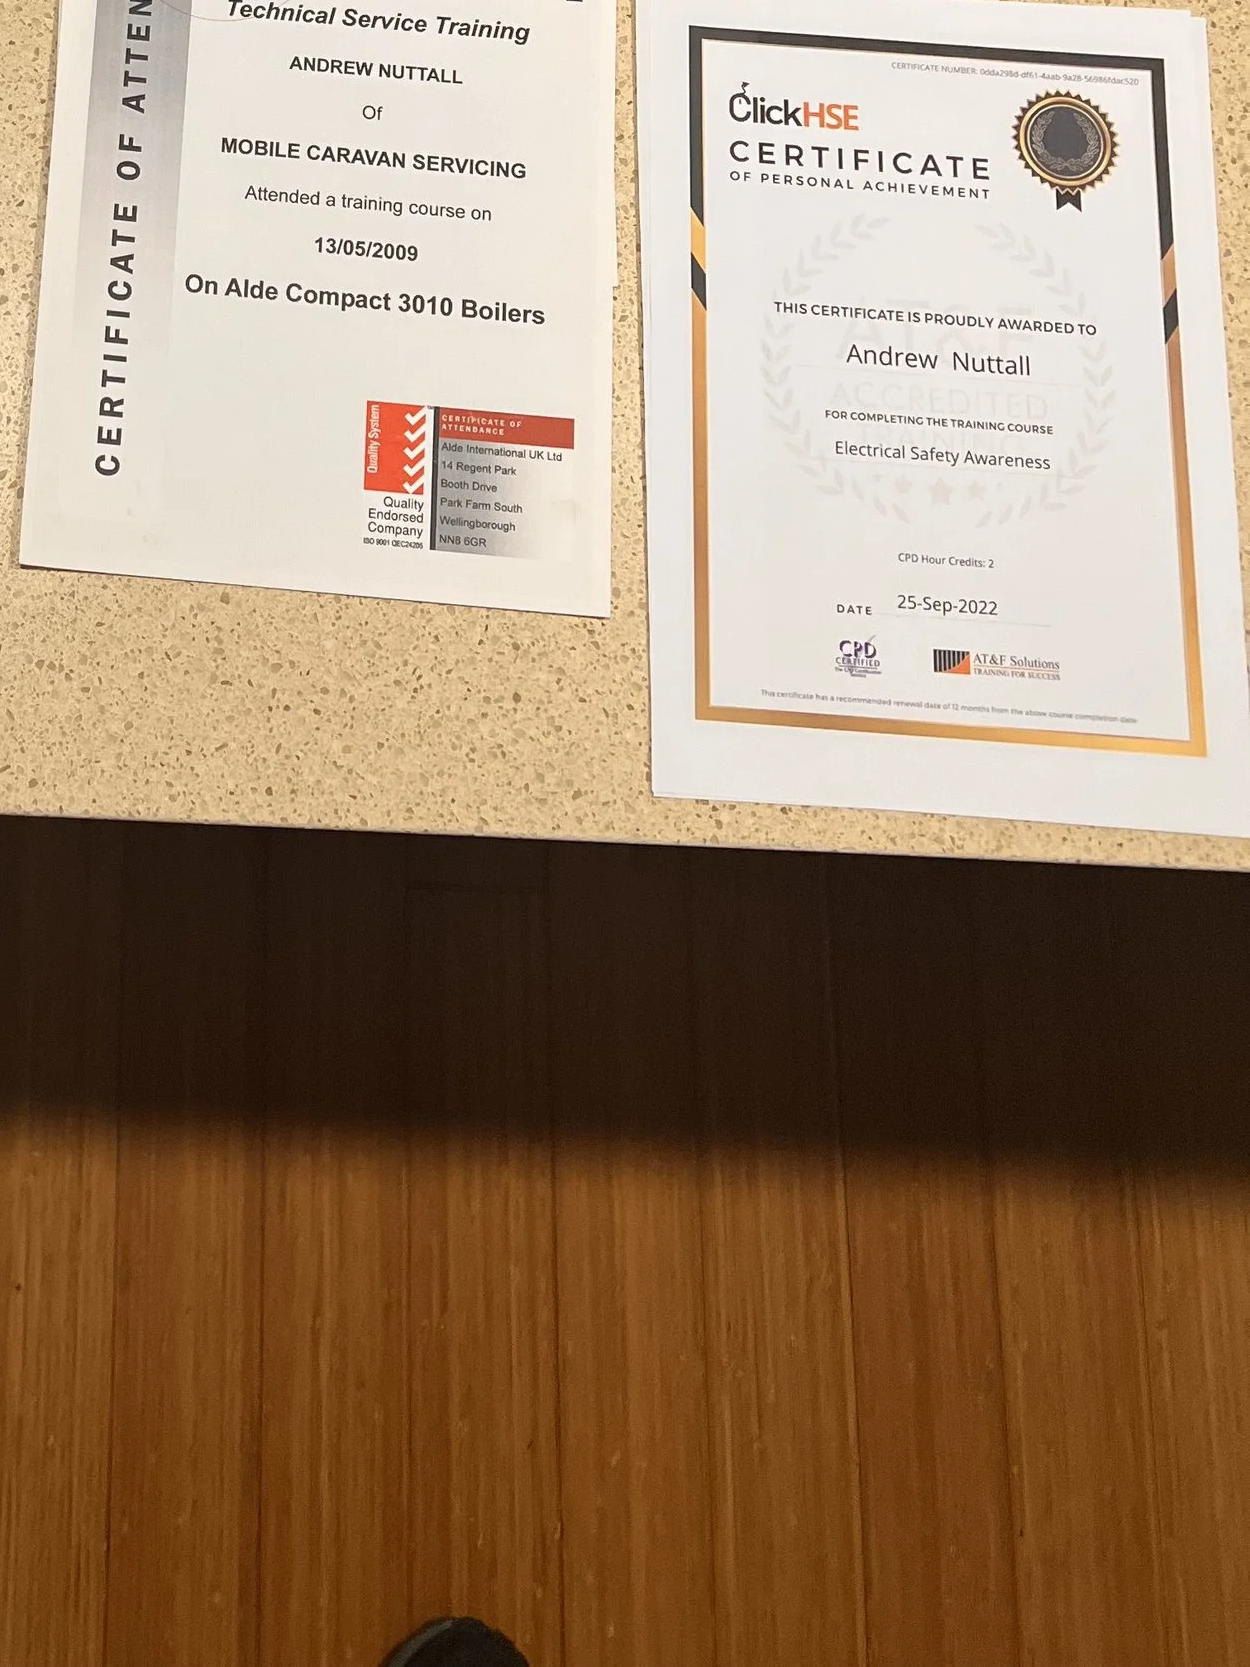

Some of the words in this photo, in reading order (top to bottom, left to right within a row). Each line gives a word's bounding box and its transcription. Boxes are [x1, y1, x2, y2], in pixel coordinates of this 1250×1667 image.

[340, 7, 428, 33] Service
[435, 14, 531, 46] Training
[288, 54, 374, 77] ANDREW
[377, 62, 463, 85] NUTTALL
[729, 82, 859, 131] ClickHSE
[115, 134, 142, 181] OF
[220, 136, 301, 159] MOBILE
[305, 143, 406, 169] CARAVAN
[411, 152, 526, 179] SERVICING
[729, 140, 989, 180] CERTIFICATE
[728, 169, 752, 182] OF
[759, 171, 854, 190] PERSONAL
[861, 179, 990, 200] ACHIEVEMENT
[313, 235, 418, 262] 13/05/2009
[184, 272, 218, 295] On
[284, 281, 391, 312] Compact
[397, 292, 453, 317] 3010
[460, 297, 545, 325] Boilers
[95, 203, 138, 476] CERTIFICATE
[845, 342, 939, 370] Andrew
[951, 350, 1031, 376] Nuttall
[834, 439, 906, 459] Electrical
[909, 445, 960, 467] Safety
[962, 449, 1051, 470] Awareness
[366, 506, 424, 528] Endorsed
[382, 494, 425, 513] Quality
[366, 520, 424, 540] Company
[896, 593, 998, 616] 25-Sep-2022
